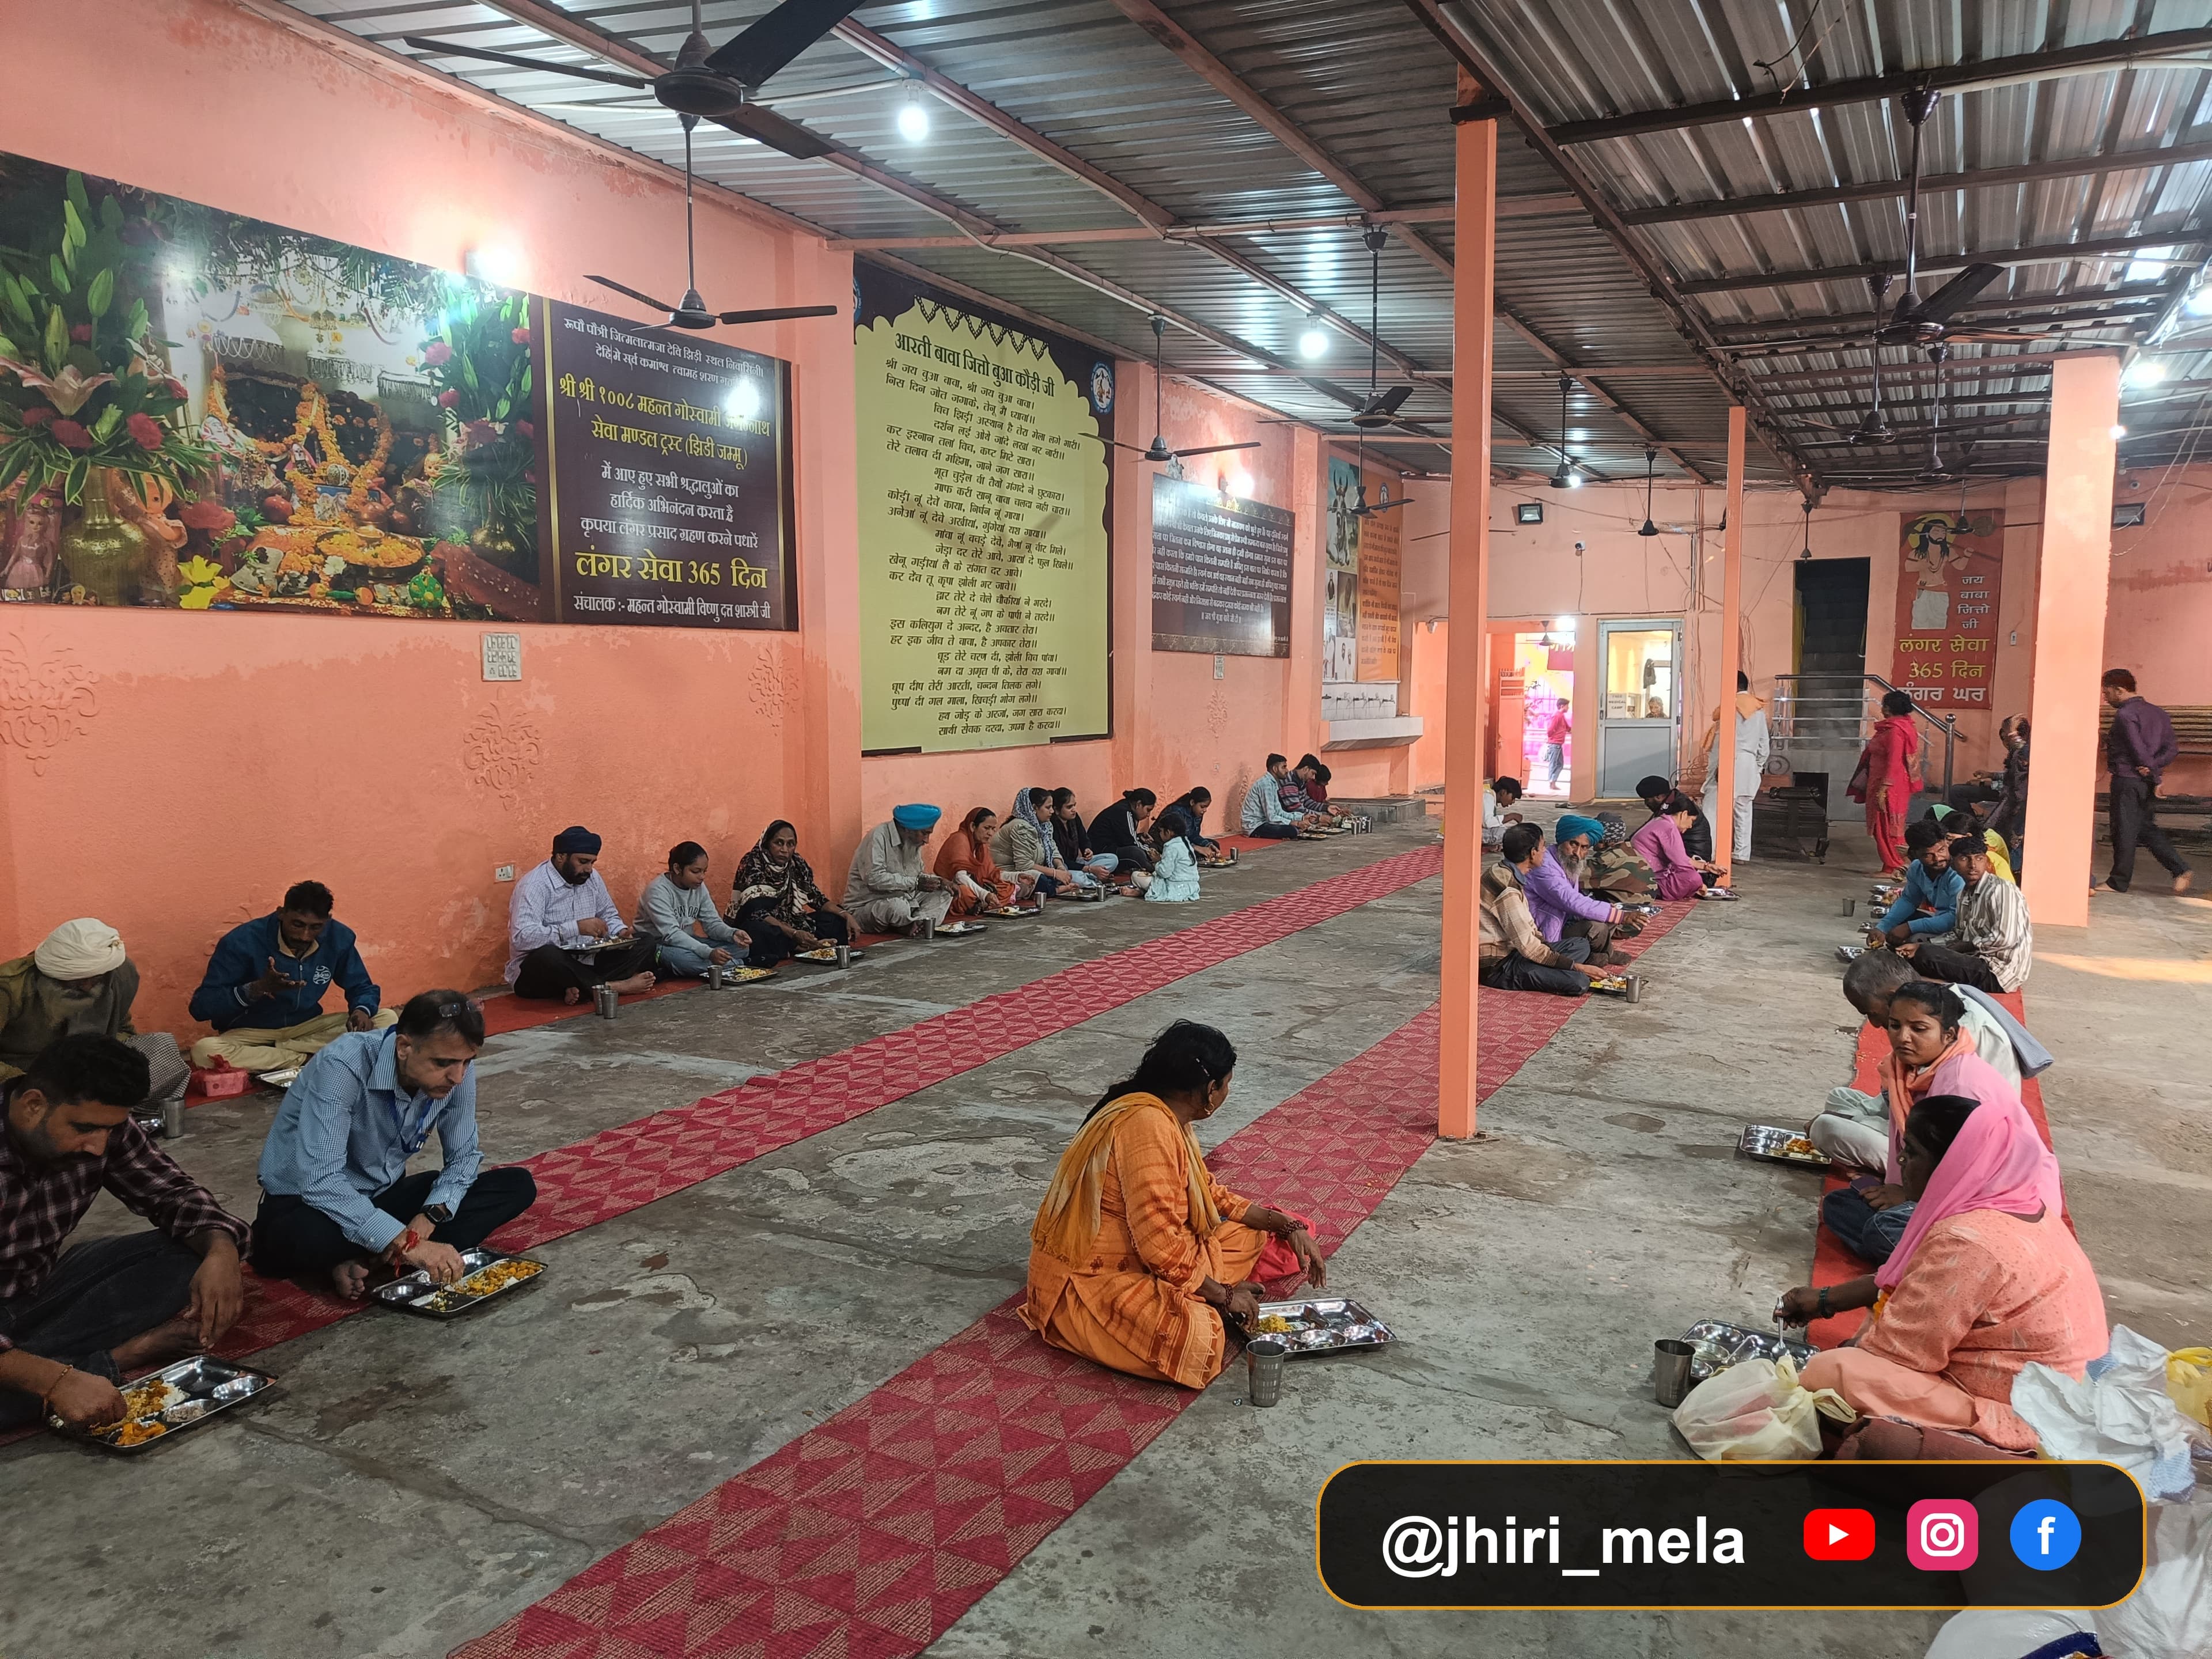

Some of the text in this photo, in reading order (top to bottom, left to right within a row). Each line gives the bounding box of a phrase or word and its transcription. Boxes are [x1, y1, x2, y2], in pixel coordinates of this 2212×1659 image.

[666, 342, 682, 357] देवि
[705, 354, 725, 368] स्थल
[895, 332, 932, 359] आरती
[963, 349, 991, 377] जित्तो
[991, 363, 1014, 388] बुआ
[1041, 376, 1055, 397] जी
[902, 363, 919, 376] जय
[980, 387, 995, 398] जय
[909, 379, 927, 394] दिन
[559, 373, 576, 399] श्री
[579, 377, 595, 402] श्री
[600, 387, 634, 410] १००८
[637, 395, 673, 418] महन्त
[674, 398, 721, 427] गोस्वामी
[590, 414, 619, 441] सेवा
[620, 426, 658, 448] मण्डल
[660, 433, 683, 456] ट्रस्ट
[886, 424, 903, 437] कर
[886, 438, 902, 452] तेरे
[601, 460, 740, 499] में आए हुए सभी श्रद्धालुओं का
[609, 490, 646, 510] हार्दिक
[647, 495, 695, 517] अभिनंदन
[696, 505, 725, 521] करता
[580, 517, 759, 548] कृपया लंगर प्रसाद ग्रहण करने पधारें
[574, 545, 768, 589] लंगर सेवा 365 दिन
[953, 560, 963, 571] के
[889, 571, 906, 582] कर
[1961, 575, 1985, 585] जय
[953, 589, 967, 602] तेरे
[969, 591, 977, 603] दे
[1960, 590, 1990, 600] बाबा
[573, 591, 616, 612] संचालक
[626, 598, 656, 614] महन्त
[656, 594, 695, 615] गोस्वामी
[696, 597, 720, 623] विष्णु
[760, 601, 771, 619] जी
[954, 605, 967, 617] तेरे
[996, 608, 1005, 619] के
[1957, 603, 1991, 614] जित्तो
[946, 619, 955, 631] दे
[1961, 618, 1980, 629] जी
[1899, 633, 1990, 652] लंगर सेवा
[954, 649, 967, 661] तेरे
[1908, 660, 1987, 679] 365 दिन
[974, 707, 983, 719] के
